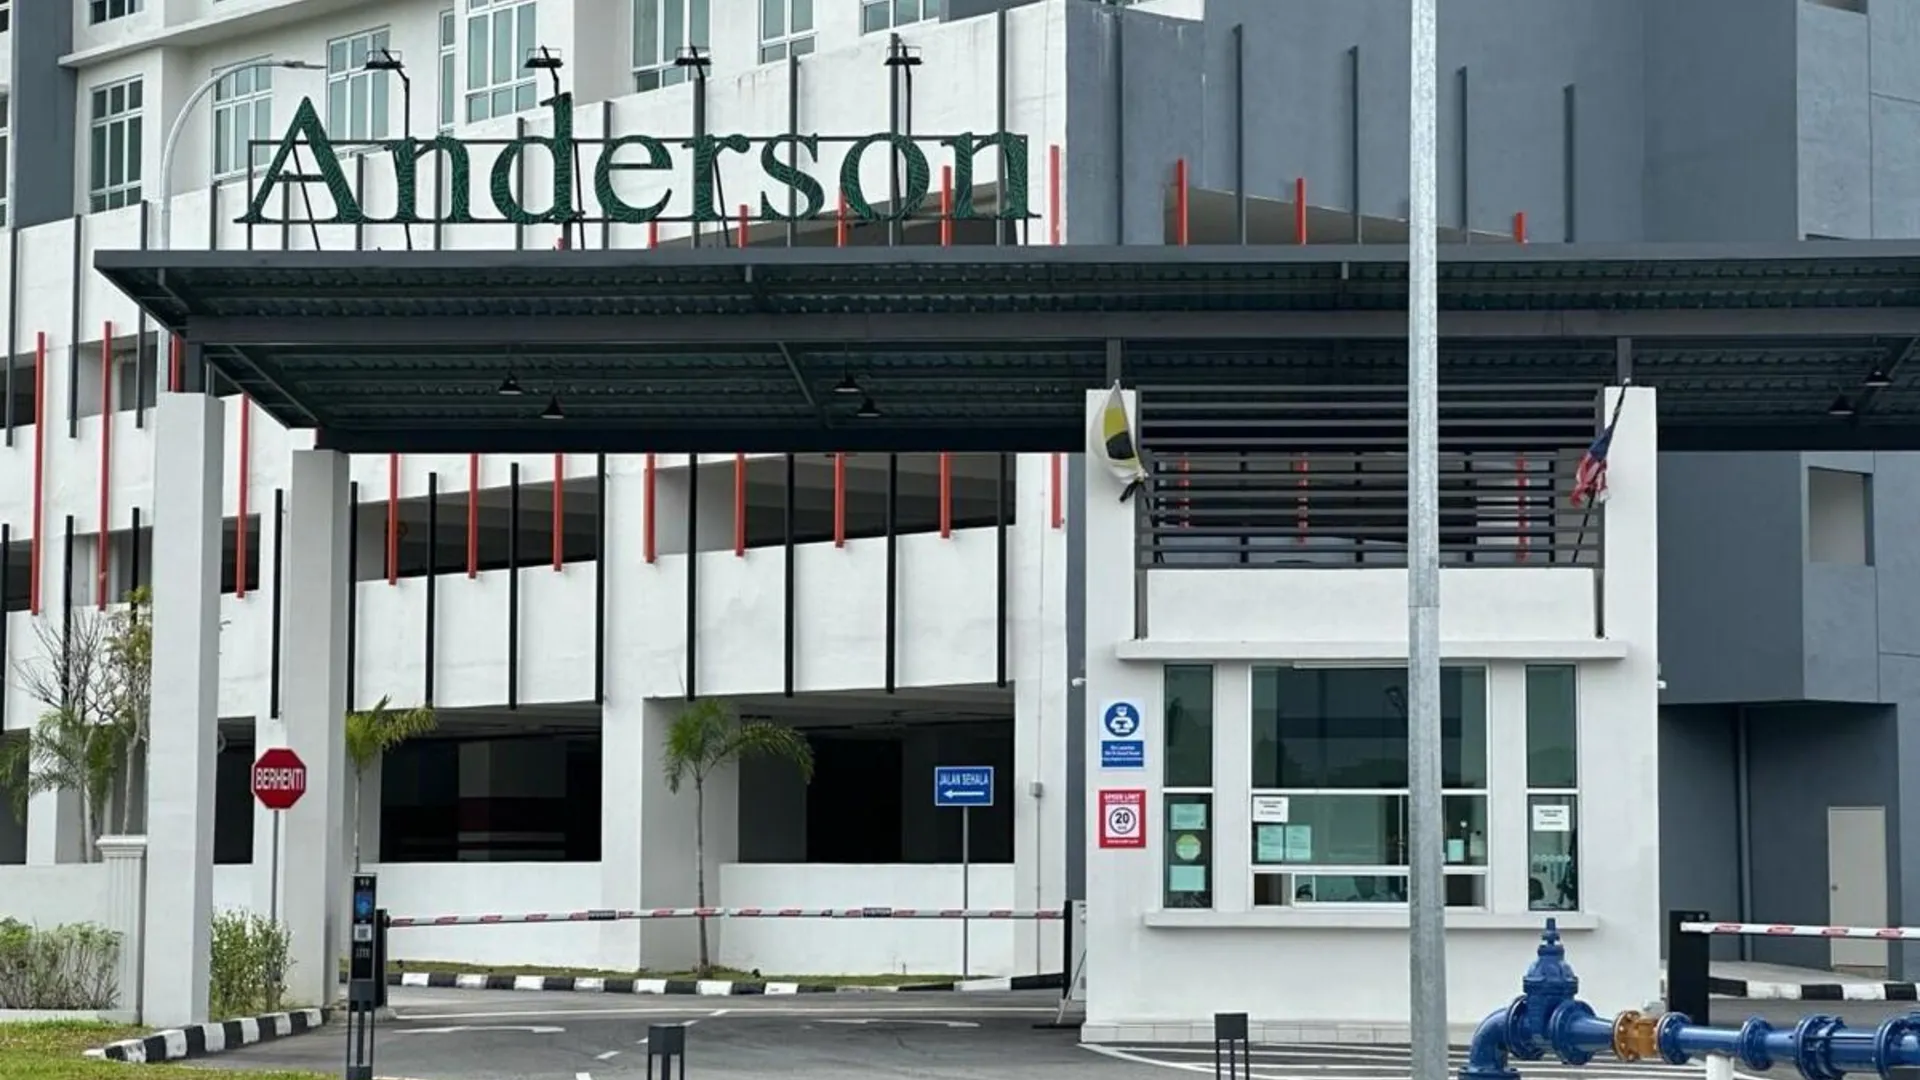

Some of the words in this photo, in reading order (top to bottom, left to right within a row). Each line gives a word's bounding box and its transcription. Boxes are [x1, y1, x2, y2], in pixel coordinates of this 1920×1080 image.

[232, 92, 1042, 224] Anderson
[255, 767, 304, 790] BERHENTI
[939, 773, 961, 785] JALAN
[962, 773, 989, 785] SEHALA
[1115, 812, 1130, 824] 20
